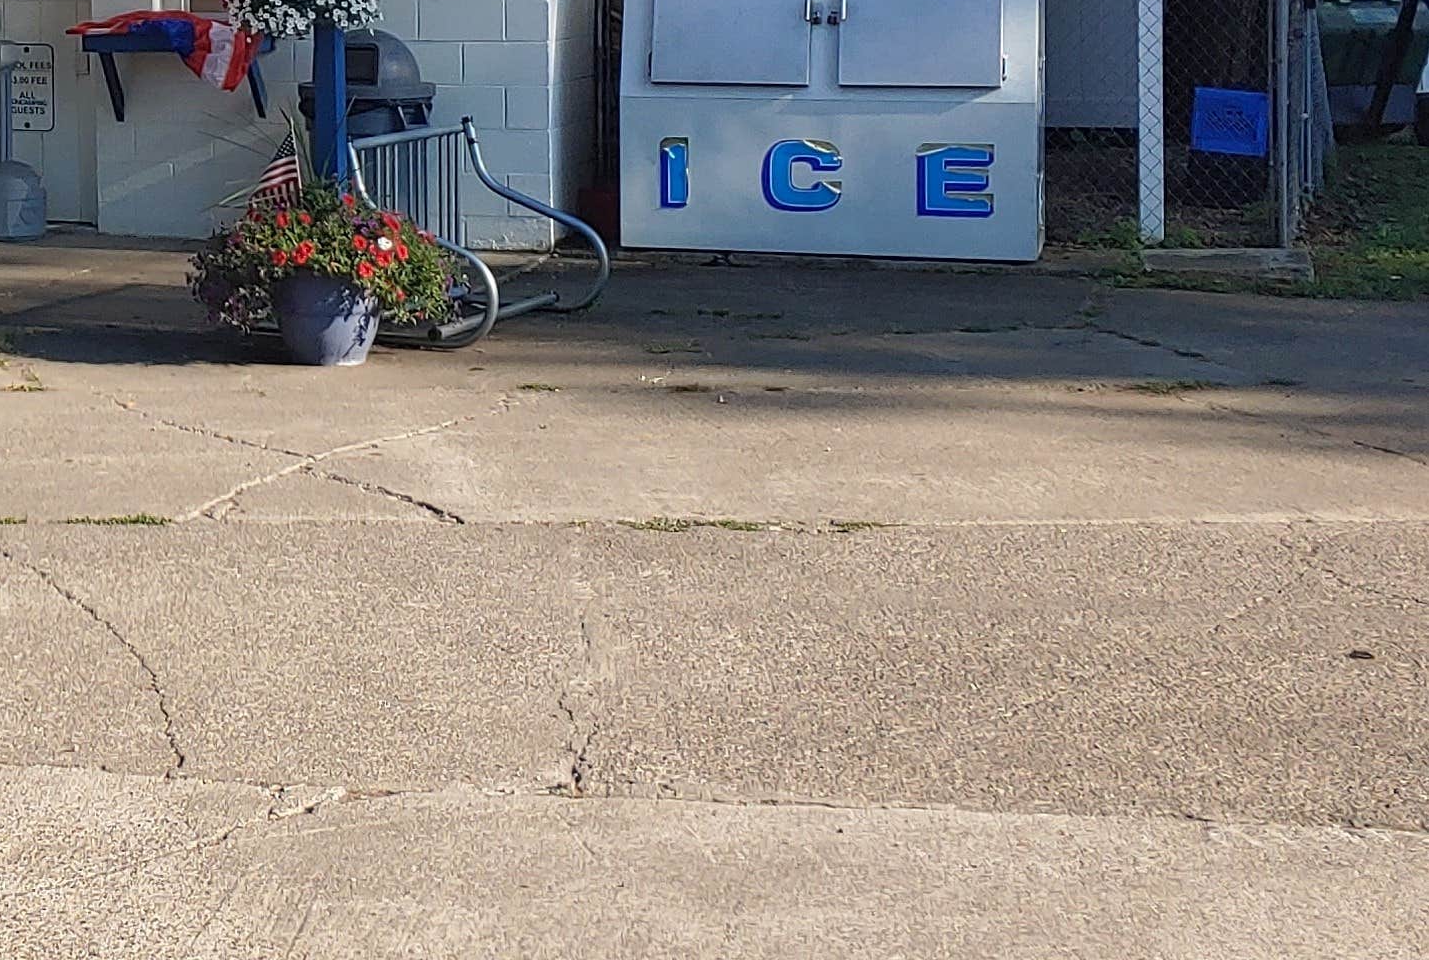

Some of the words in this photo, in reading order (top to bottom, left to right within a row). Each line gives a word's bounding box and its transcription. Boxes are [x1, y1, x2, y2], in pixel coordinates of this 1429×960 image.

[30, 76, 48, 85] FEE
[18, 91, 35, 99] ALL
[659, 136, 995, 218] ICE
